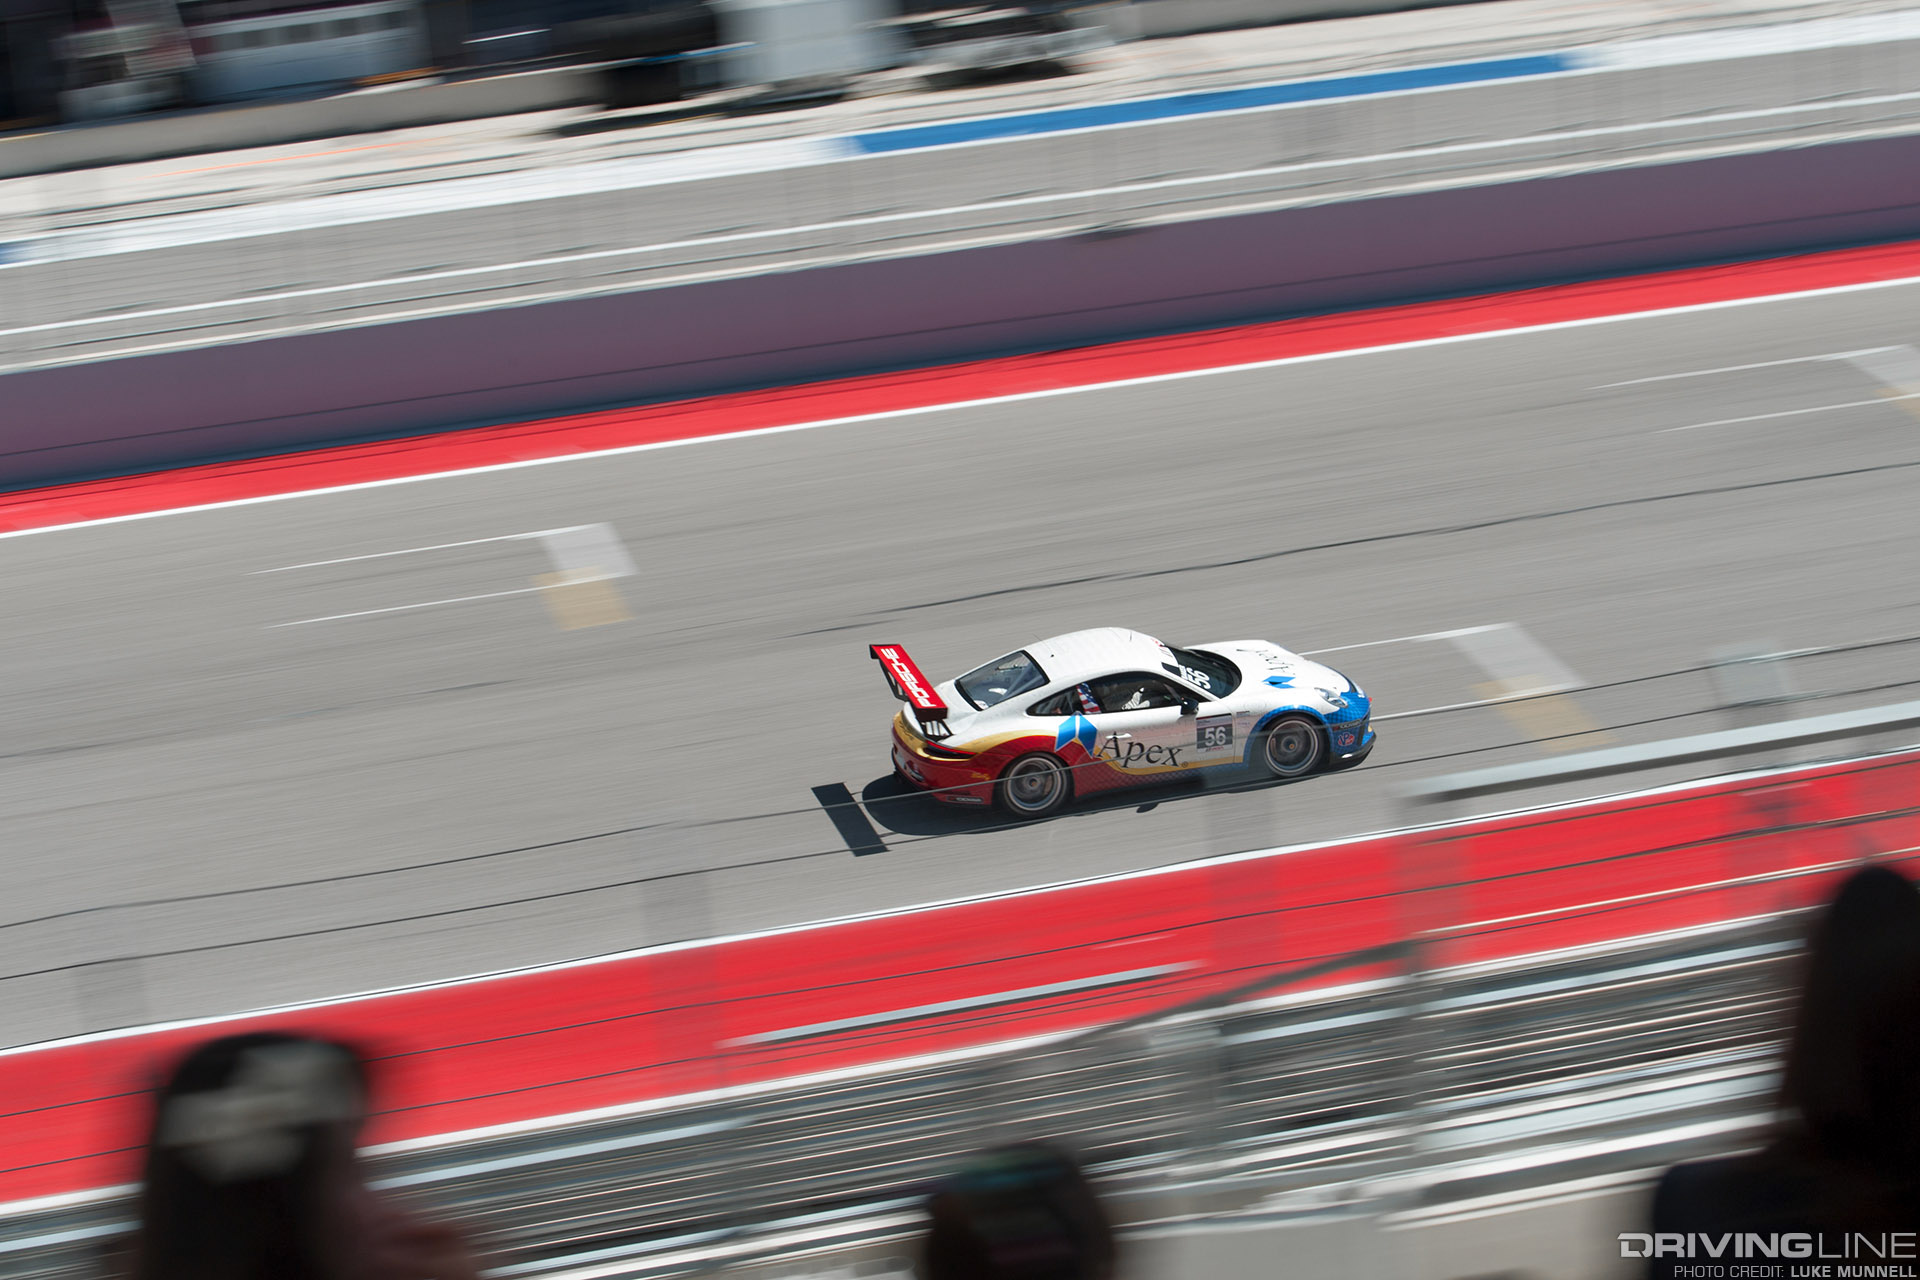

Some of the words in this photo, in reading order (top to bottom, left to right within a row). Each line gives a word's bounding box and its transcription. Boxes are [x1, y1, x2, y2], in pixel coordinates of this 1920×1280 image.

[880, 648, 936, 707] PORSCHE
[1096, 731, 1183, 768] Apex
[1205, 726, 1226, 746] 56
